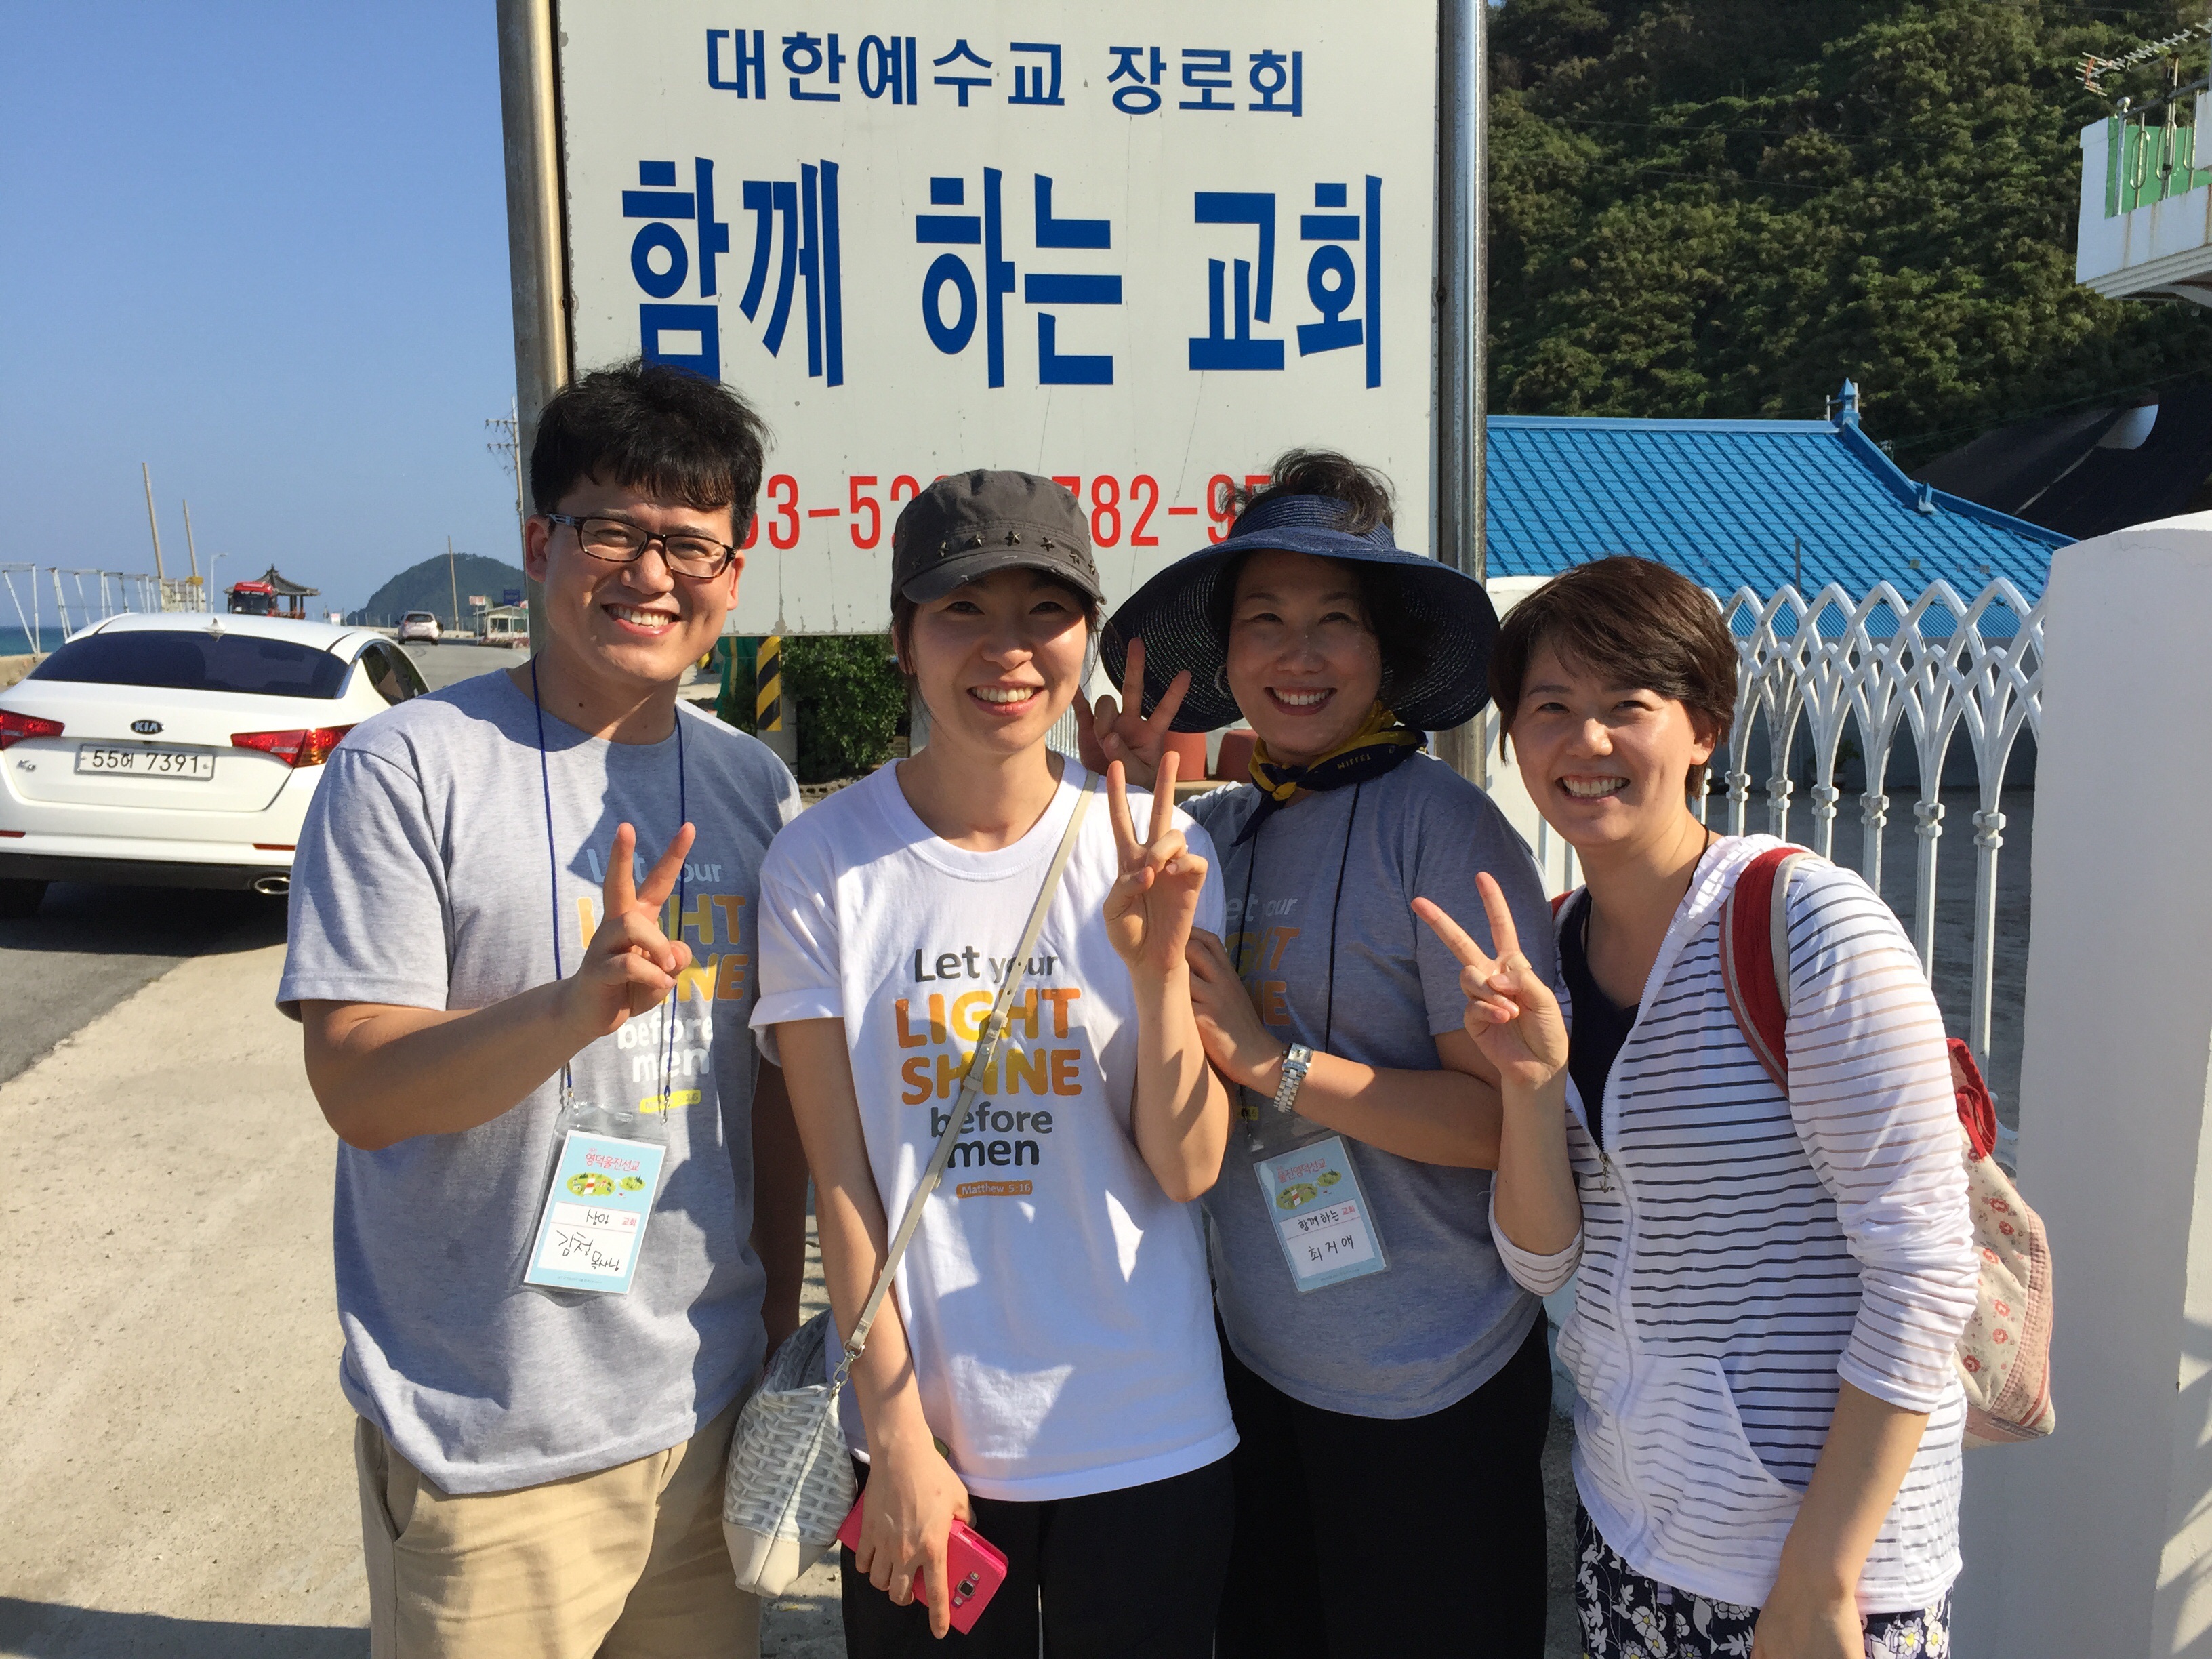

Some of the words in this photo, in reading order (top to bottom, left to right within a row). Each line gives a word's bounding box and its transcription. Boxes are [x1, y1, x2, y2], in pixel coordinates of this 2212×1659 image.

[707, 30, 1064, 106] 대한예수교
[1108, 47, 1302, 116] 장로회
[622, 157, 843, 386] 함께
[915, 167, 1122, 388] 하는
[1188, 175, 1382, 388] 교회
[135, 722, 158, 732] KIA
[92, 750, 134, 769] 55허
[146, 752, 199, 773] 7391
[586, 848, 647, 884] Lt
[679, 862, 722, 882] our
[577, 893, 747, 950] LHT
[1226, 893, 1259, 922] et
[1261, 897, 1298, 917] our
[915, 945, 981, 983] Let
[1225, 926, 1301, 977] GHT
[617, 1011, 714, 1050] before
[895, 987, 1082, 1048] LIGHT
[632, 1048, 710, 1083] men
[901, 1048, 1082, 1105] SHINE
[930, 1101, 1053, 1138] before
[586, 1153, 640, 1172] 영덕울진선교
[947, 1140, 1040, 1168] men
[962, 1183, 1004, 1195] Matthew
[1008, 1183, 1031, 1193] 5:16
[621, 1216, 636, 1227] 교회
[1342, 1205, 1355, 1216] 교회
